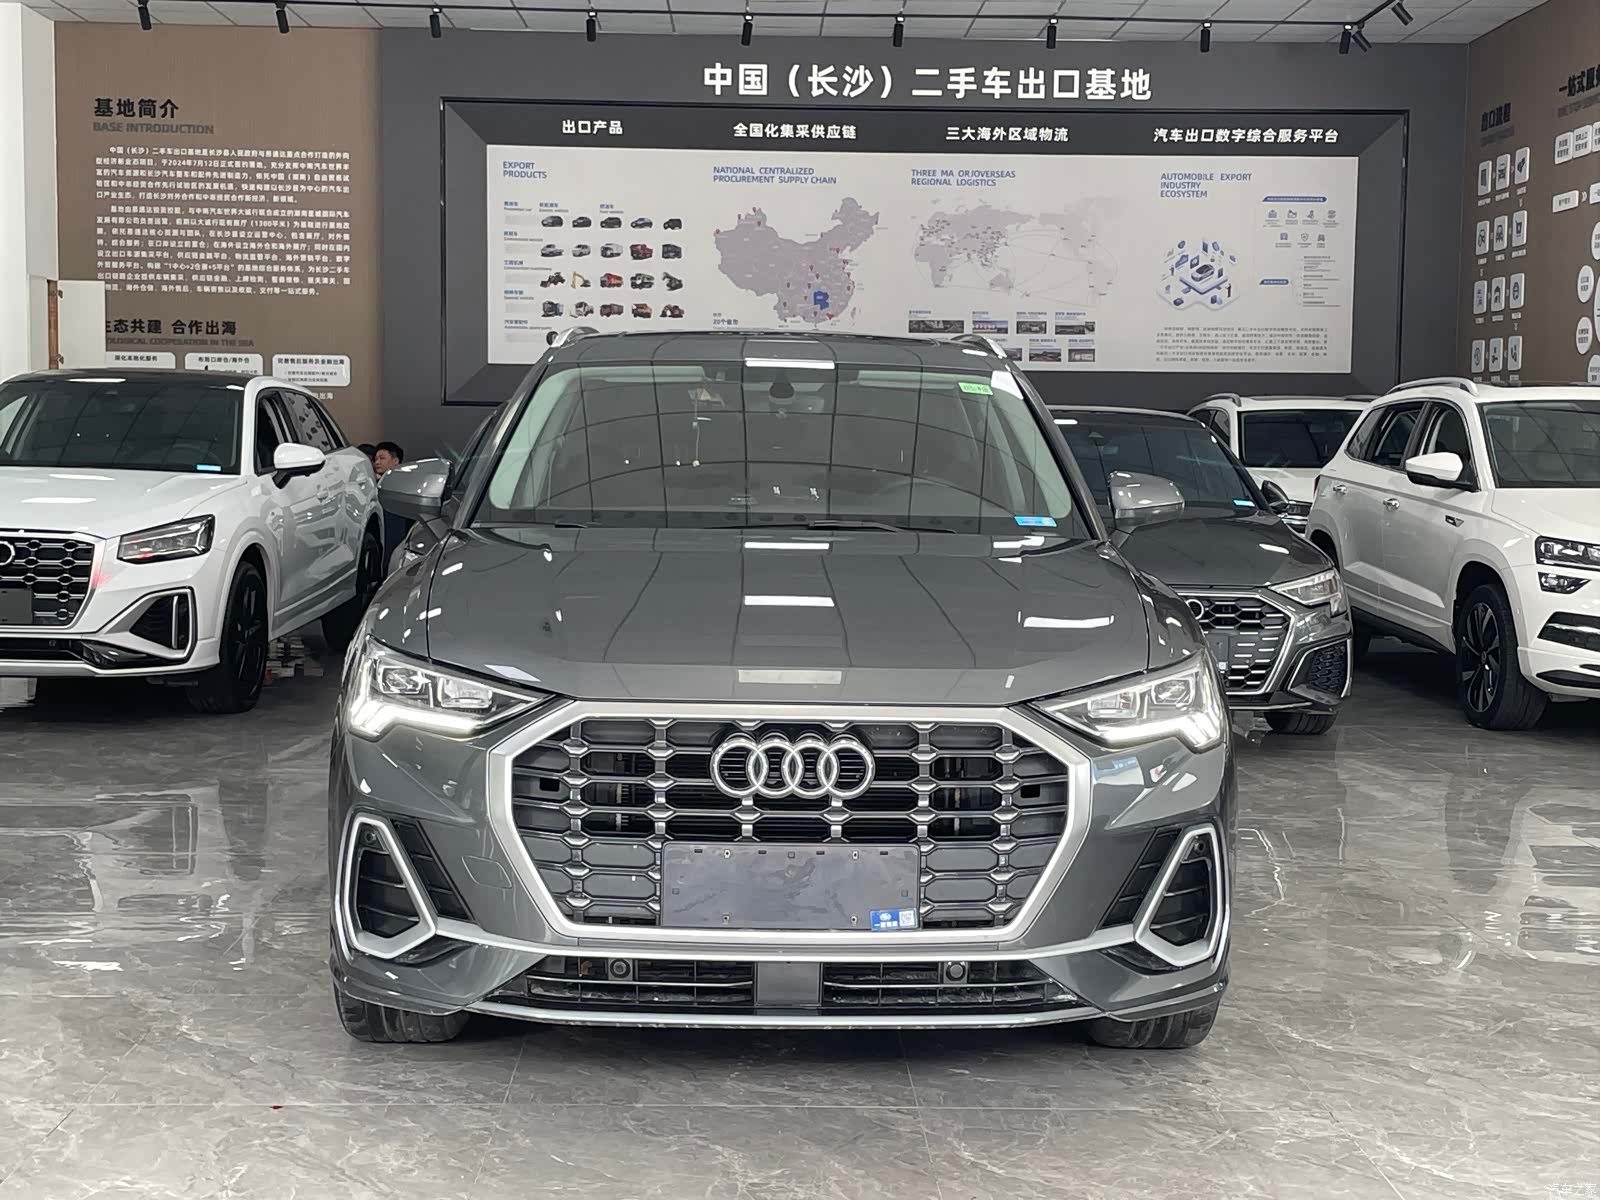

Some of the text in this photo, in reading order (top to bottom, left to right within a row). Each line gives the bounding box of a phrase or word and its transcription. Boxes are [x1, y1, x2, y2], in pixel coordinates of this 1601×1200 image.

[704, 62, 1152, 101] 中国（长沙）二手车出口基地
[94, 98, 179, 119] 基地简介
[93, 122, 214, 134] BASE INTRODUCTION
[562, 119, 623, 135] 出口产品
[733, 122, 857, 139] 全国化集采供应链
[945, 126, 1069, 142] 三大海外区域物流
[1153, 127, 1339, 143] 汽车出口数字综合服务平台
[503, 161, 535, 170] EXPORT
[503, 170, 547, 179] PRODUCTS
[713, 166, 814, 175] NATIONAL CENTRALIZED
[912, 169, 936, 177] THREE
[941, 170, 954, 178] MA
[713, 175, 774, 183] PROCUREMENT
[1161, 173, 1252, 181] AUTOMOBILE EXPORT
[911, 178, 997, 187] REGIONAL LOGISTICS
[1161, 181, 1201, 189] INDUSTRY
[1161, 190, 1208, 198] ECOSYSTEM
[171, 319, 236, 336] 合作出海
